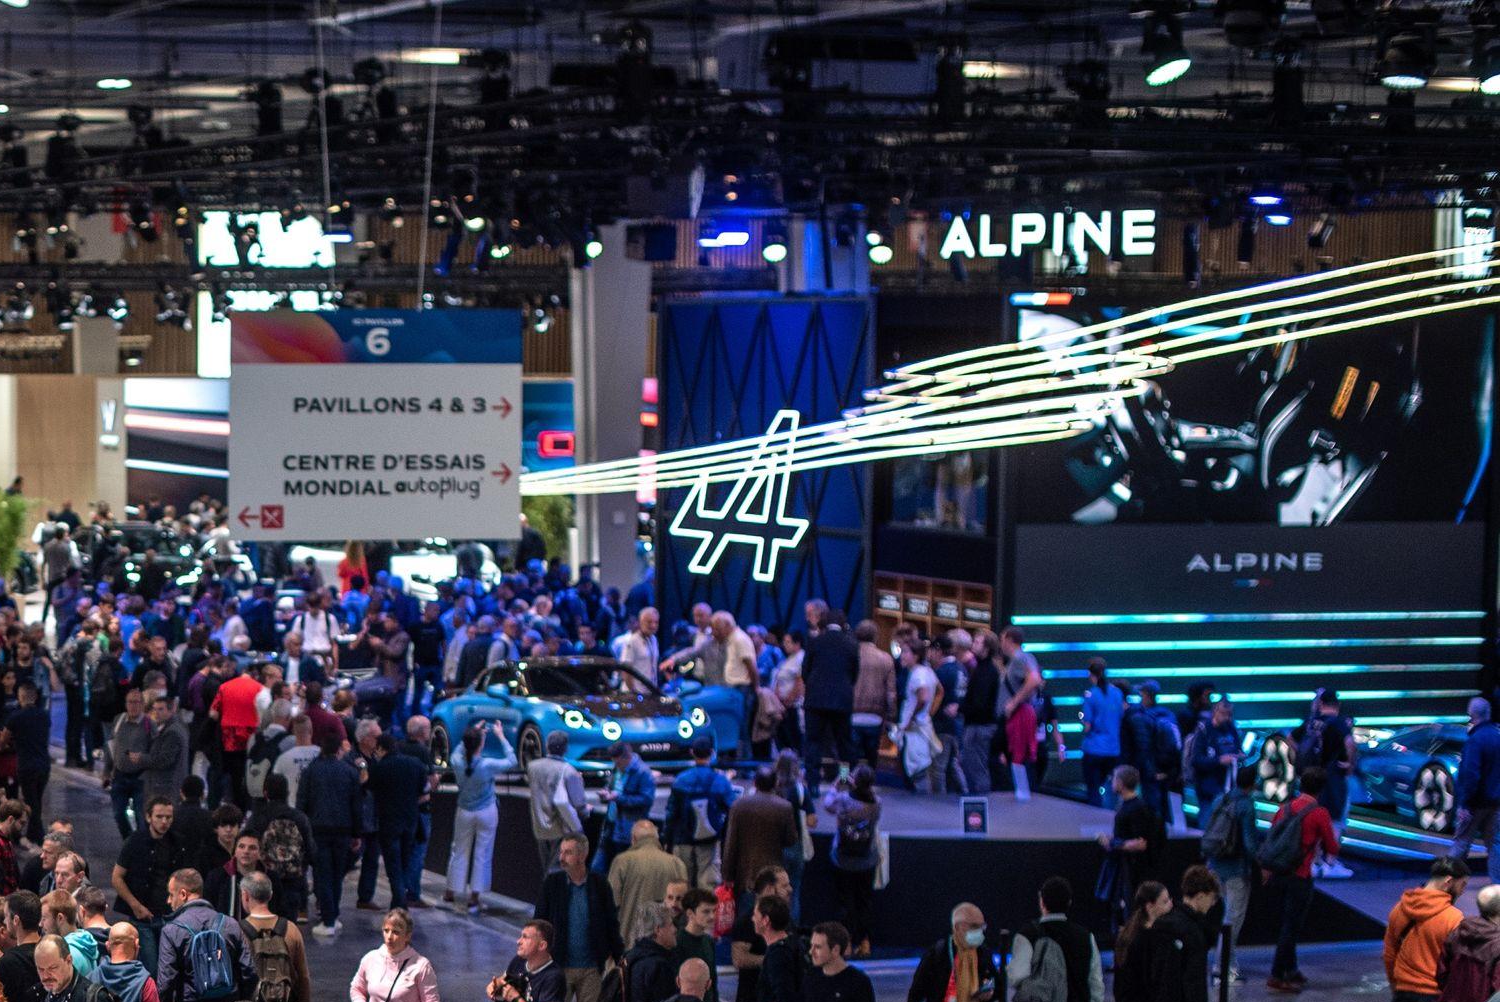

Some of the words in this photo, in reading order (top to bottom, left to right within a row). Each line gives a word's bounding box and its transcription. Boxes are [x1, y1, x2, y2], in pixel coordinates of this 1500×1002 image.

[940, 210, 1156, 259] ALPINE
[366, 327, 391, 356] 6
[294, 397, 421, 413] PAVILLONS
[428, 398, 442, 412] 4
[450, 397, 464, 413] &
[472, 398, 487, 413] 3
[283, 455, 375, 471] CENTRE
[383, 454, 486, 470] D'ESSAIS
[284, 479, 390, 496] MONDIAL
[1186, 552, 1323, 572] ALPINE
